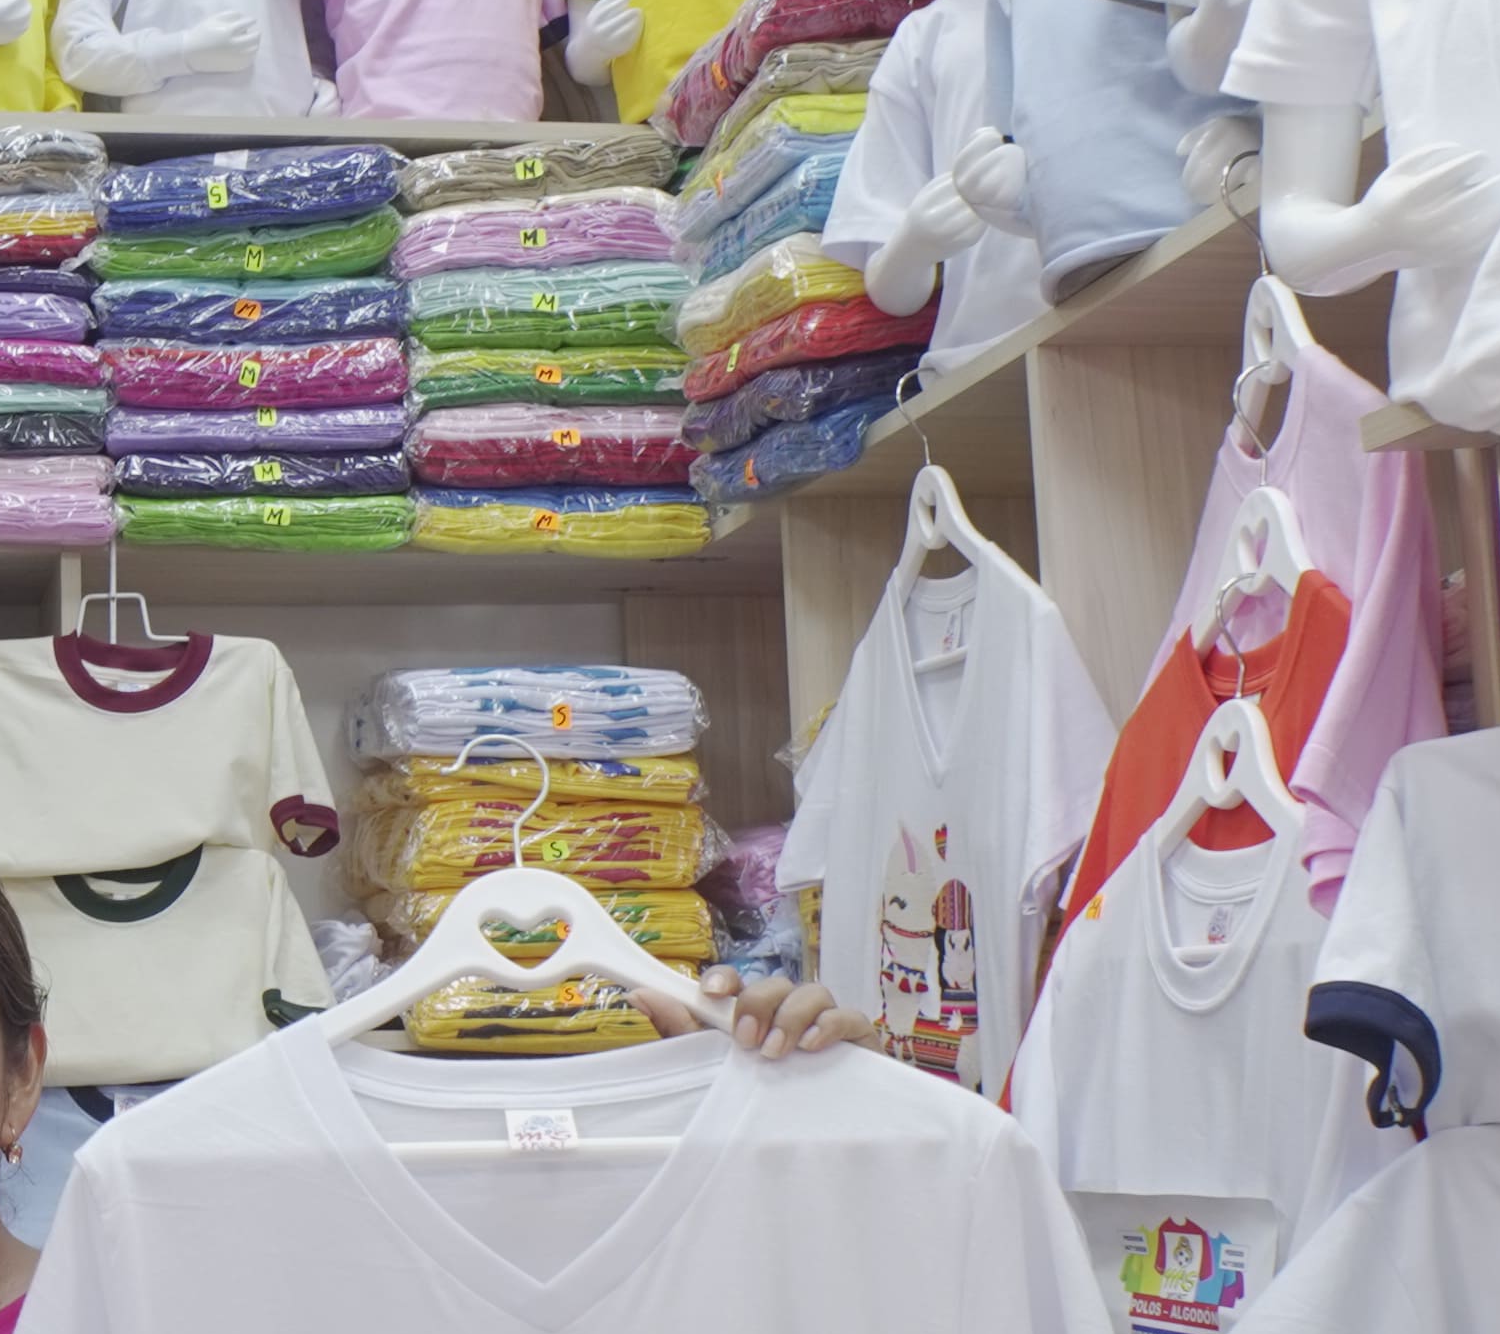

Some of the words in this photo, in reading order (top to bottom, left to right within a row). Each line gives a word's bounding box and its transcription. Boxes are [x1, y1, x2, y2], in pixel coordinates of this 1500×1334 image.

[208, 185, 222, 204] S
[522, 228, 539, 246] M
[245, 248, 263, 268] M
[236, 302, 258, 318] M
[535, 292, 556, 311] M
[241, 365, 256, 385] M
[537, 368, 554, 381] M
[259, 407, 274, 423] M
[559, 429, 574, 445] M
[261, 464, 275, 480] M
[266, 507, 285, 526] M
[535, 513, 553, 529] M
[556, 705, 567, 727] S
[550, 840, 564, 859] S
[563, 986, 576, 1003] S
[1130, 1299, 1162, 1317] POLOS
